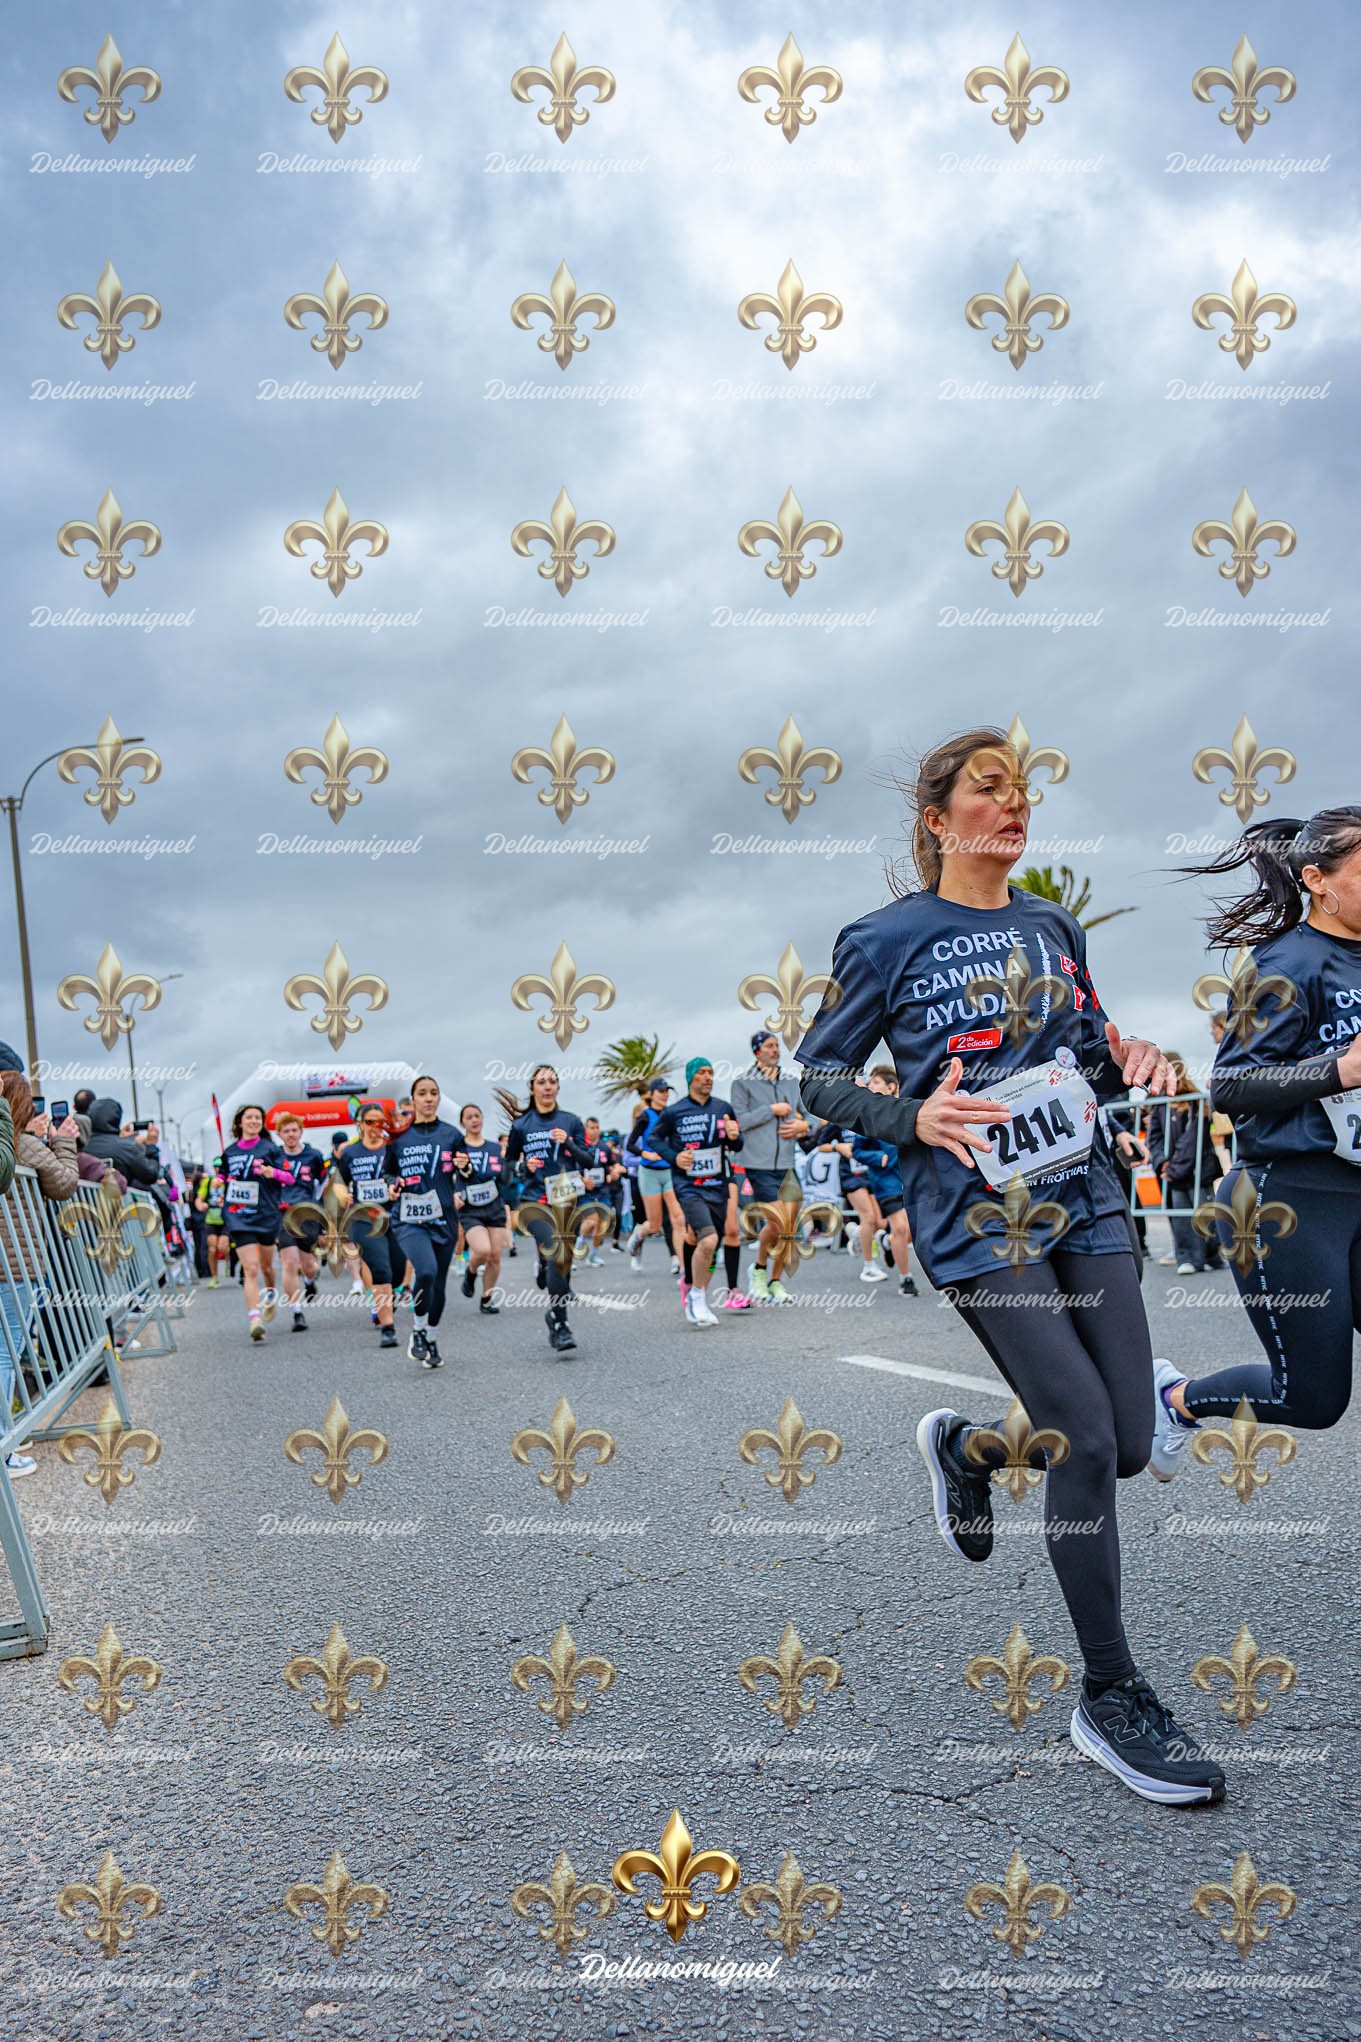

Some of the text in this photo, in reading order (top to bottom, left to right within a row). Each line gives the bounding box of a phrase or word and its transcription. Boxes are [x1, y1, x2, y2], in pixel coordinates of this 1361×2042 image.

[932, 928, 1027, 962] CORRÉ
[913, 954, 1026, 1000] CAMINÁ
[926, 986, 1020, 1031] AYUDÁ
[987, 1098, 1077, 1166] 2414
[403, 1144, 433, 1156] CORRÉ
[692, 1158, 714, 1171] 2541
[406, 1204, 433, 1217] 2826
